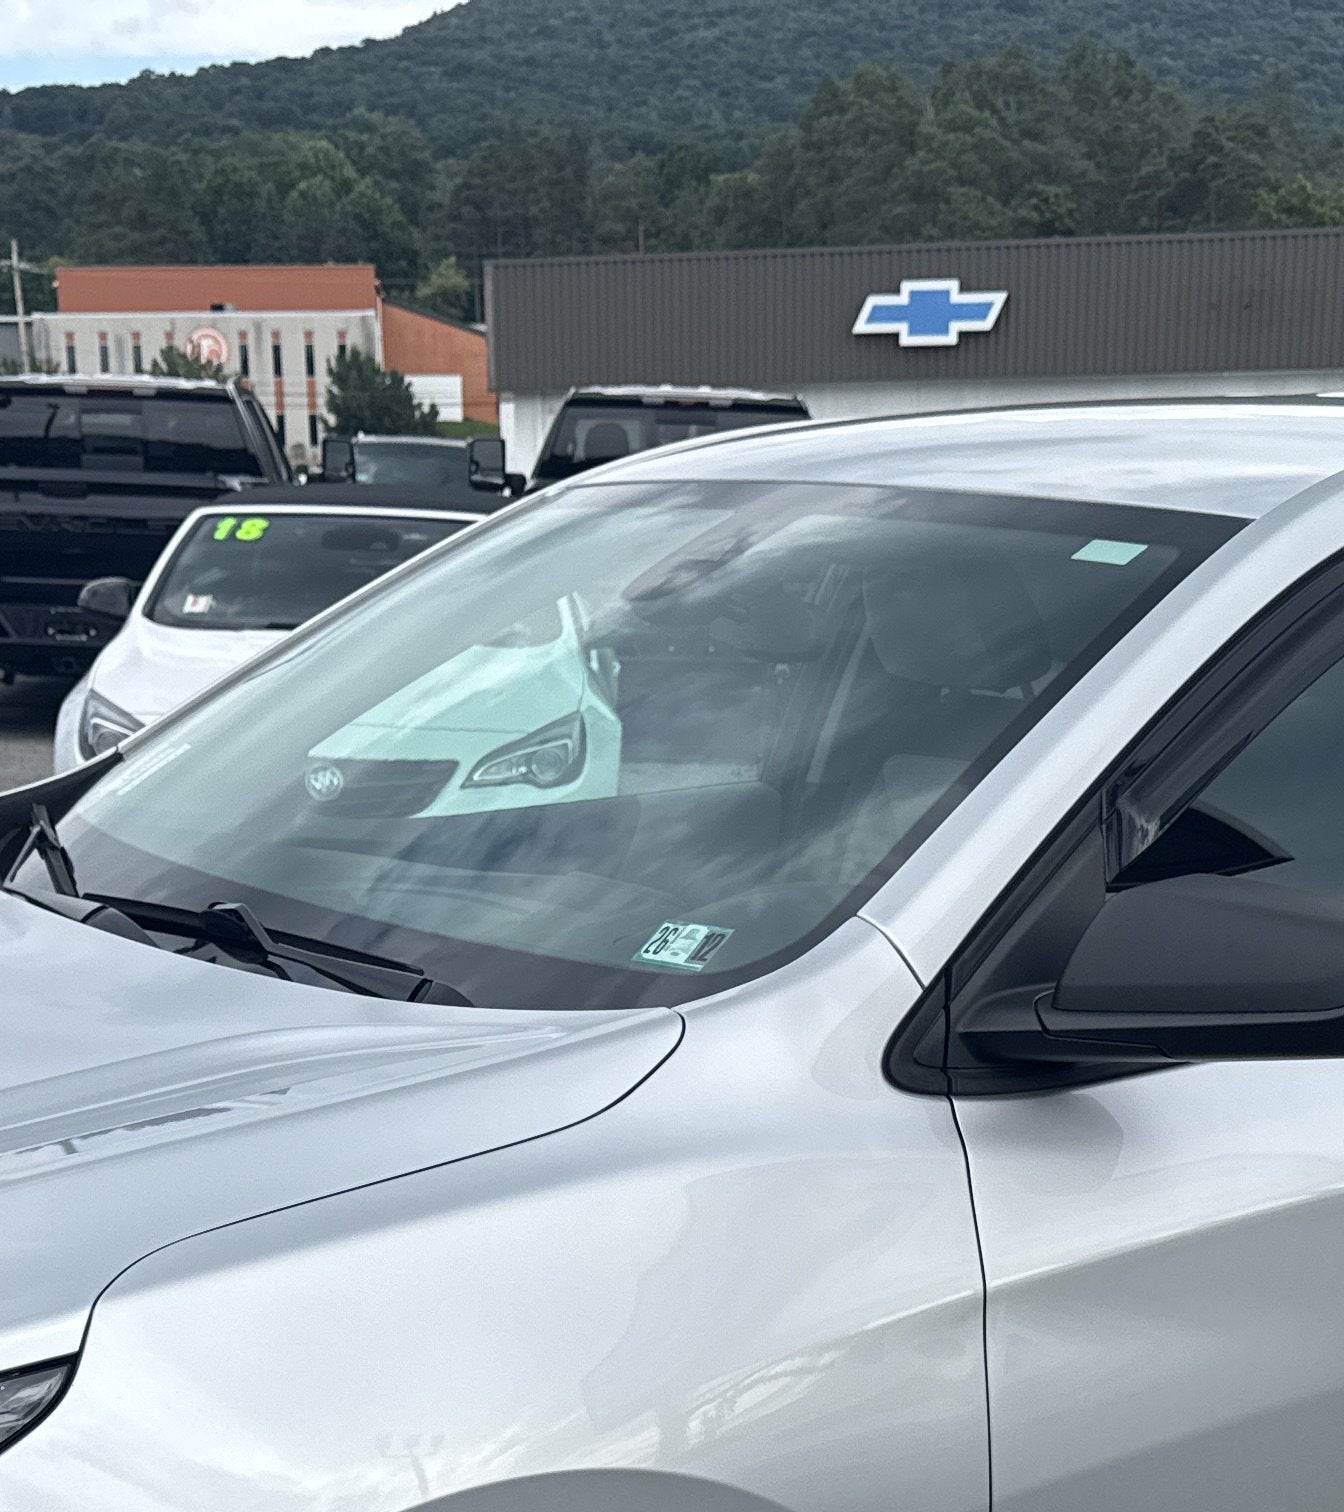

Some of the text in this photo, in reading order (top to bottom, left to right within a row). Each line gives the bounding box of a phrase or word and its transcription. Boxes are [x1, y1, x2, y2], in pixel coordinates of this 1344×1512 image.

[213, 516, 270, 541] 18
[643, 925, 726, 962] 26 12
